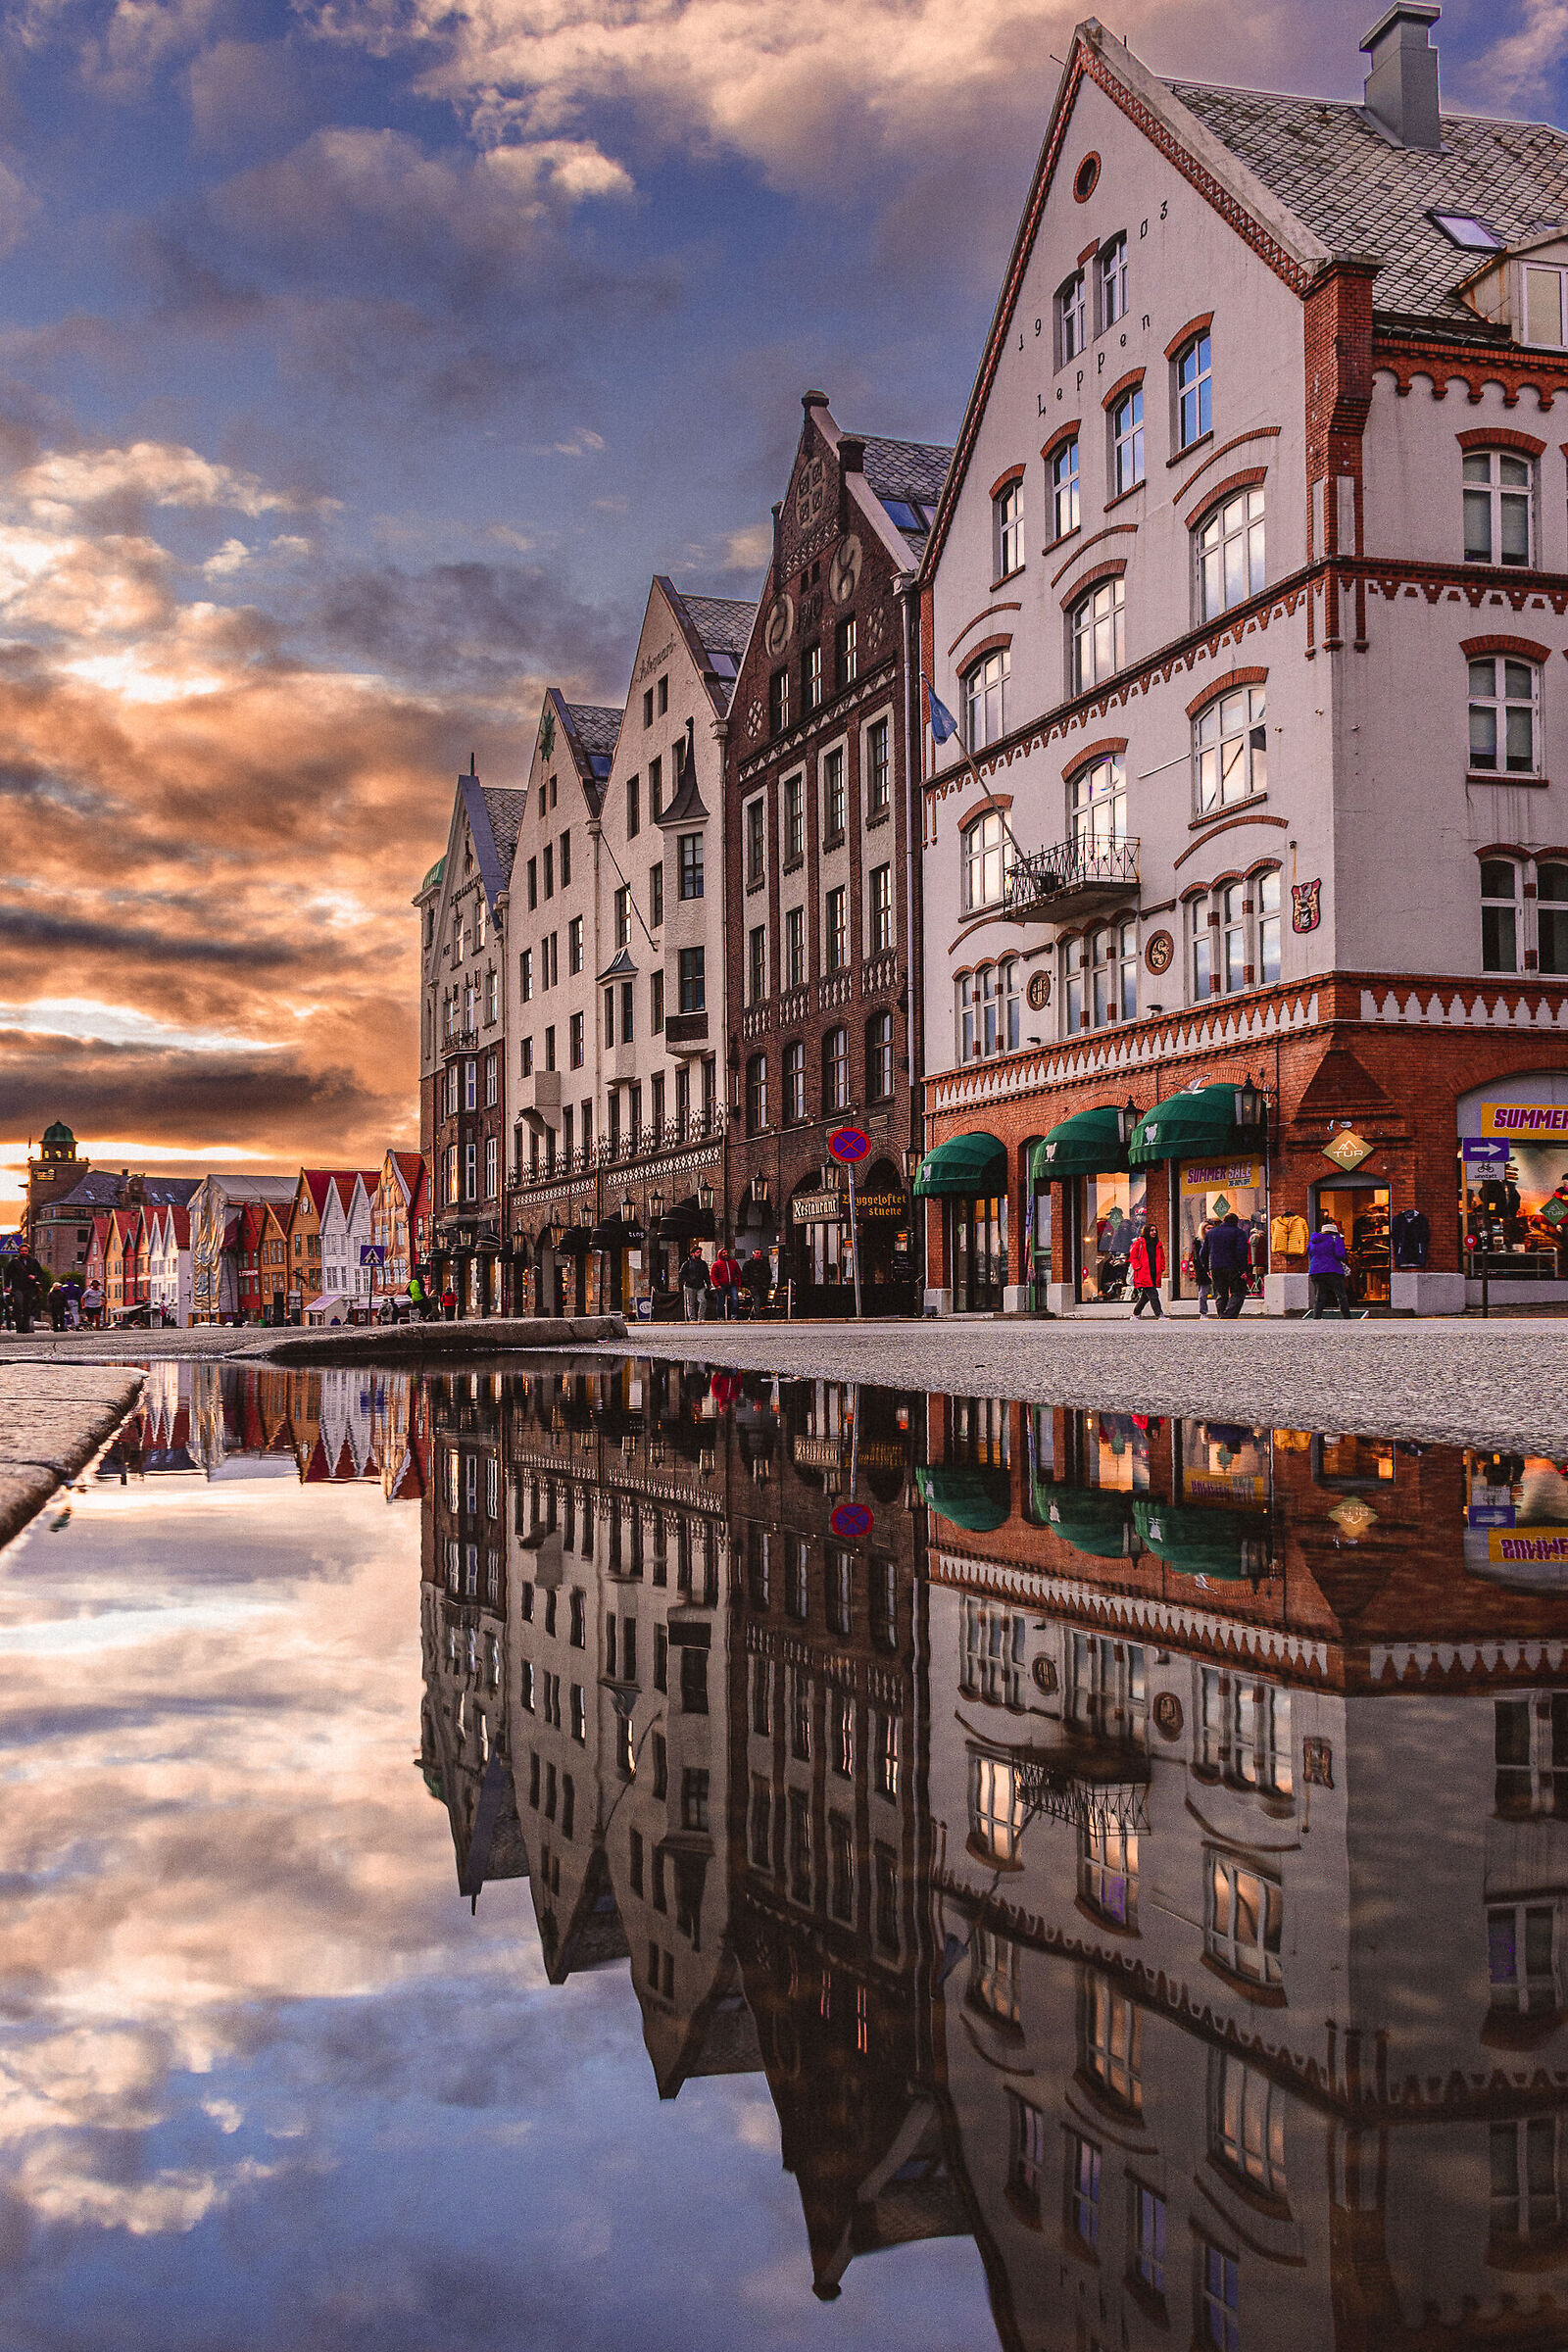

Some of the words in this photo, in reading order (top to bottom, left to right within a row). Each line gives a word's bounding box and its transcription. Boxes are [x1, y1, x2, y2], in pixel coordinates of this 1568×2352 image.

[1333, 1150, 1364, 1158] TUR
[1187, 1166, 1227, 1185] SUMMER
[1228, 1161, 1252, 1179] SALE
[842, 1193, 907, 1206] Byggeloftet
[794, 1198, 838, 1218] Restaurant
[868, 1206, 902, 1216] stuene
